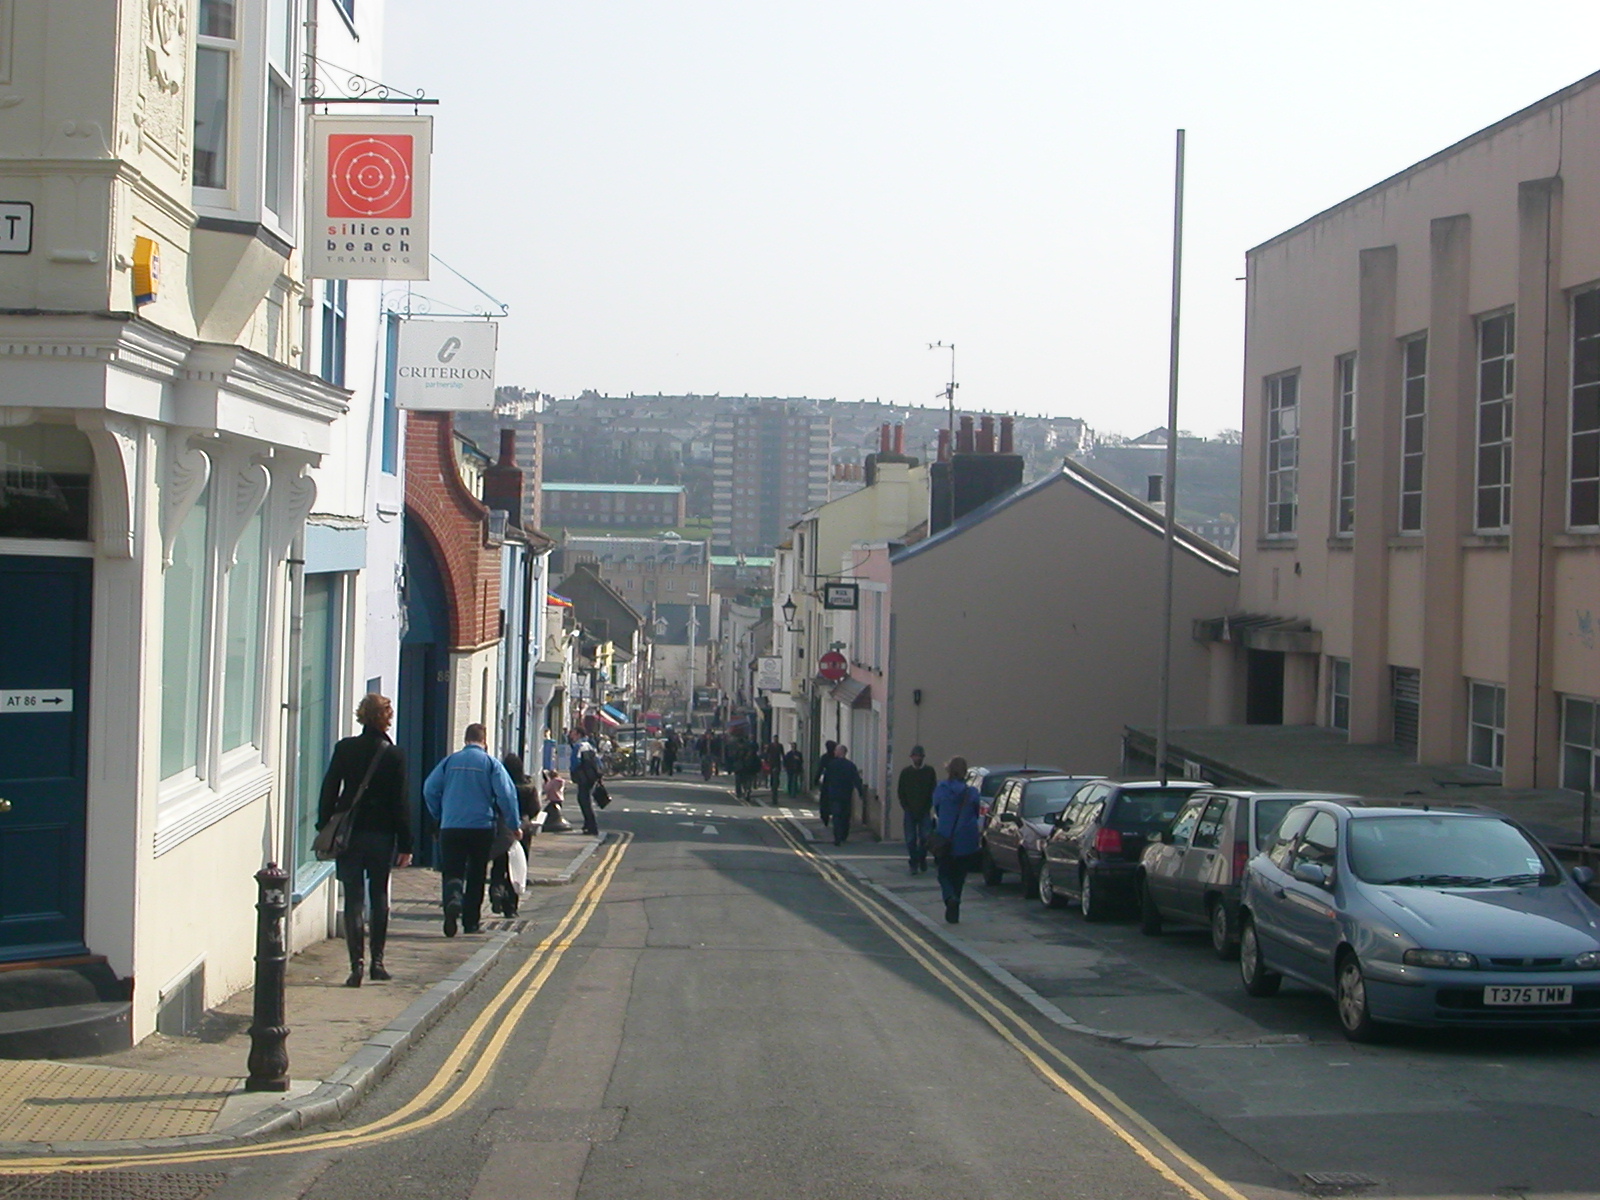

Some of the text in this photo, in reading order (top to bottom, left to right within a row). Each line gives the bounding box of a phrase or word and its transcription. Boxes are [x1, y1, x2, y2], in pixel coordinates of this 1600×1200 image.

[0, 215, 21, 240] T
[327, 223, 410, 236] silicon
[327, 239, 410, 252] beach
[327, 256, 410, 264] TRAINING
[399, 366, 493, 380] CRITERION
[425, 381, 464, 389] partnership
[6, 696, 37, 706] AT 86
[1491, 987, 1567, 1003] T375 TMW
